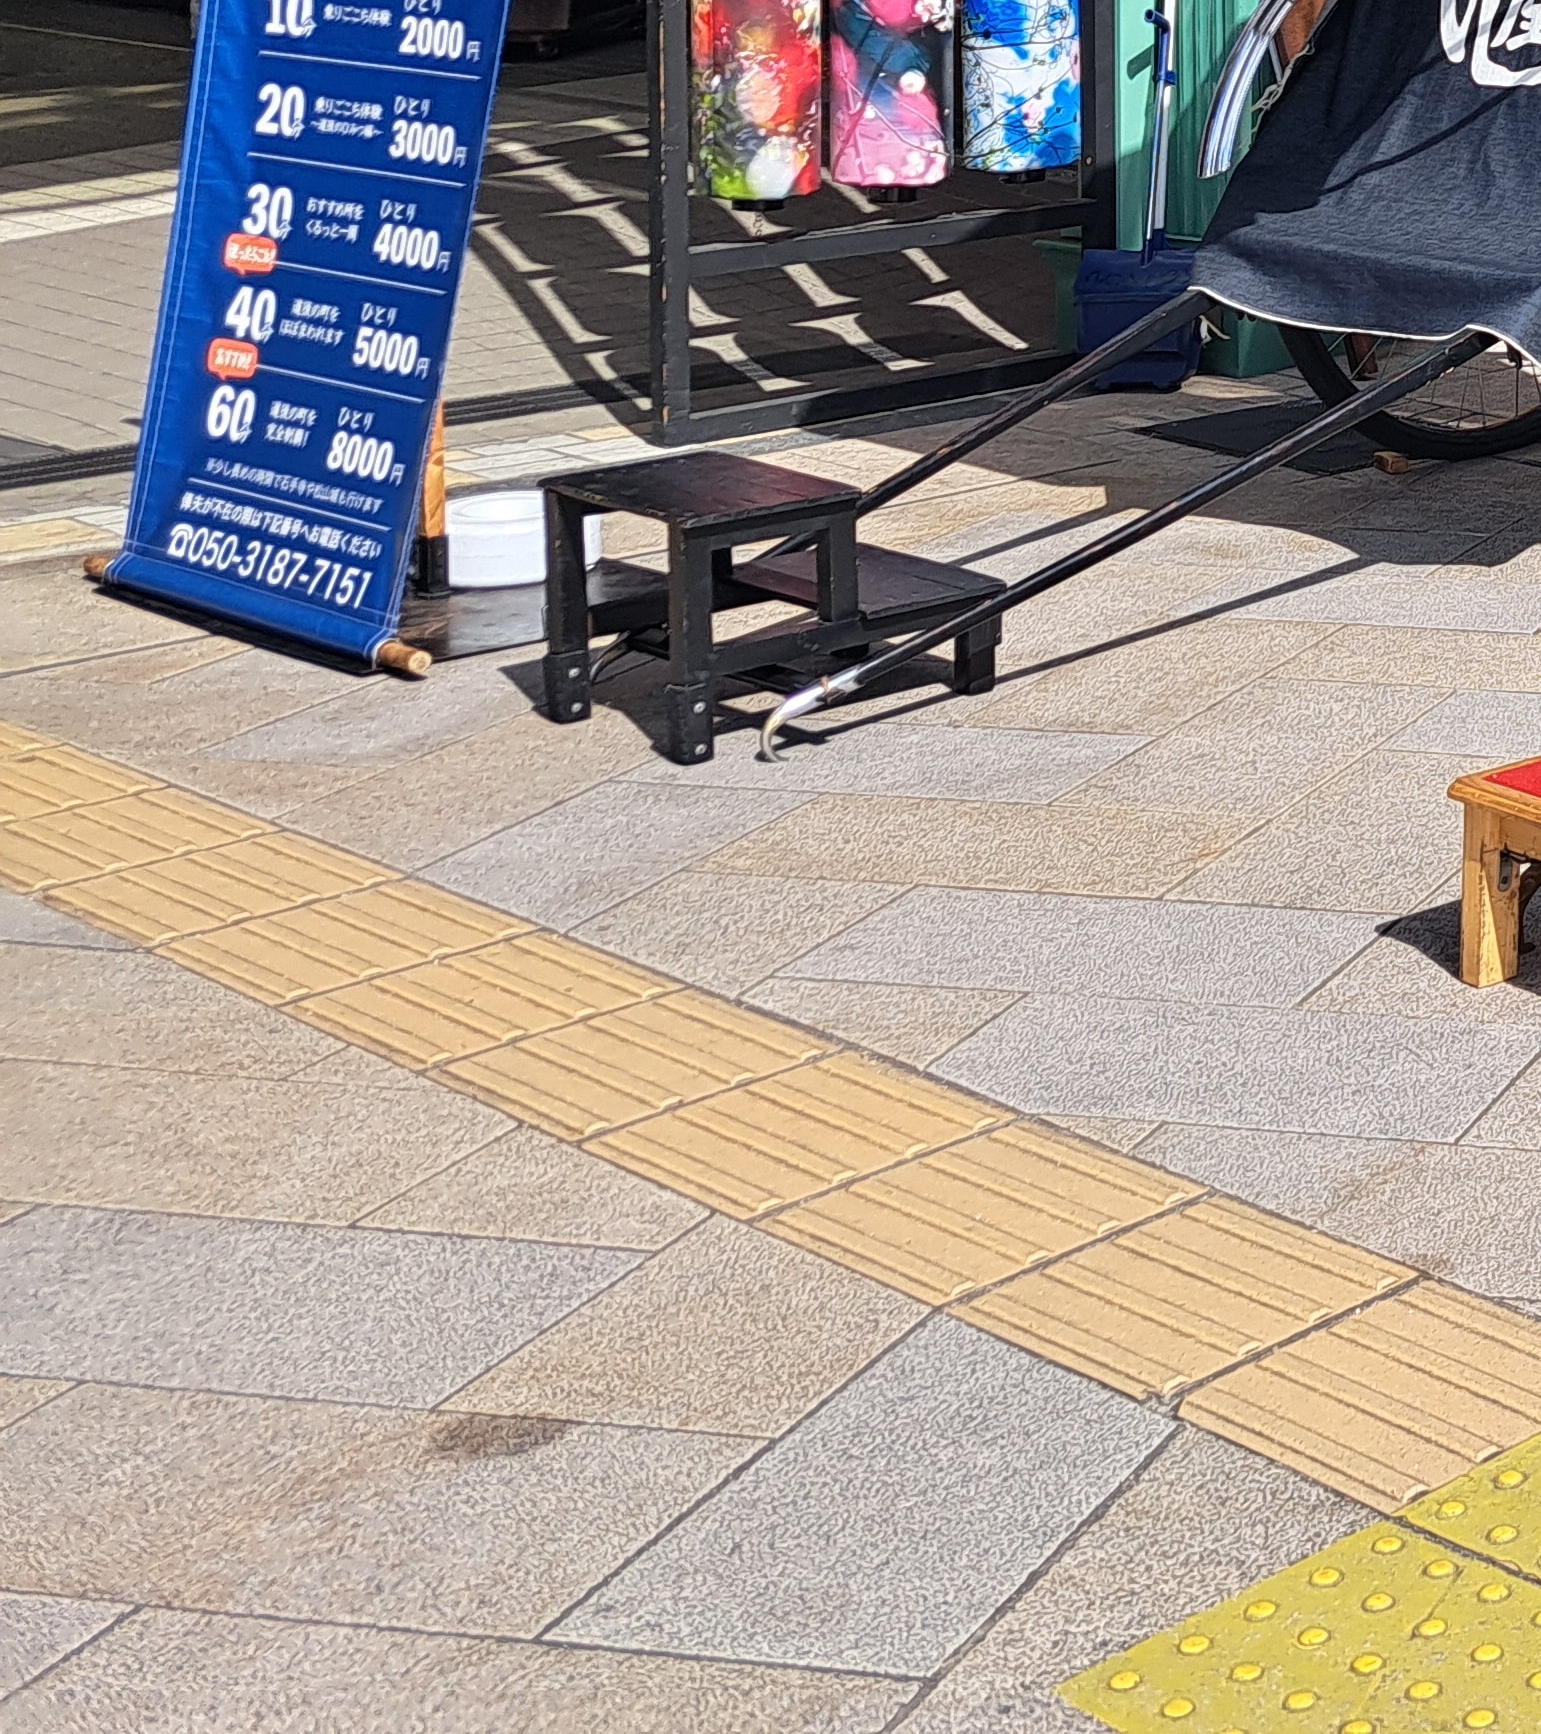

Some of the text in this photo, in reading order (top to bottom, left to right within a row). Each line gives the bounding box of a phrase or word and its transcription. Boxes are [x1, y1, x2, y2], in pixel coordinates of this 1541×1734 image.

[398, 15, 483, 63] 2000円
[393, 95, 431, 117] ひとり
[388, 119, 468, 169] 3000円
[379, 199, 418, 223] ひとり
[373, 223, 451, 273] 4000円
[360, 302, 399, 327] ひとり
[352, 326, 432, 380] 5000円
[338, 406, 375, 433] ひとり
[327, 431, 406, 486] 8000円
[189, 526, 374, 609] 050-3187-7151
